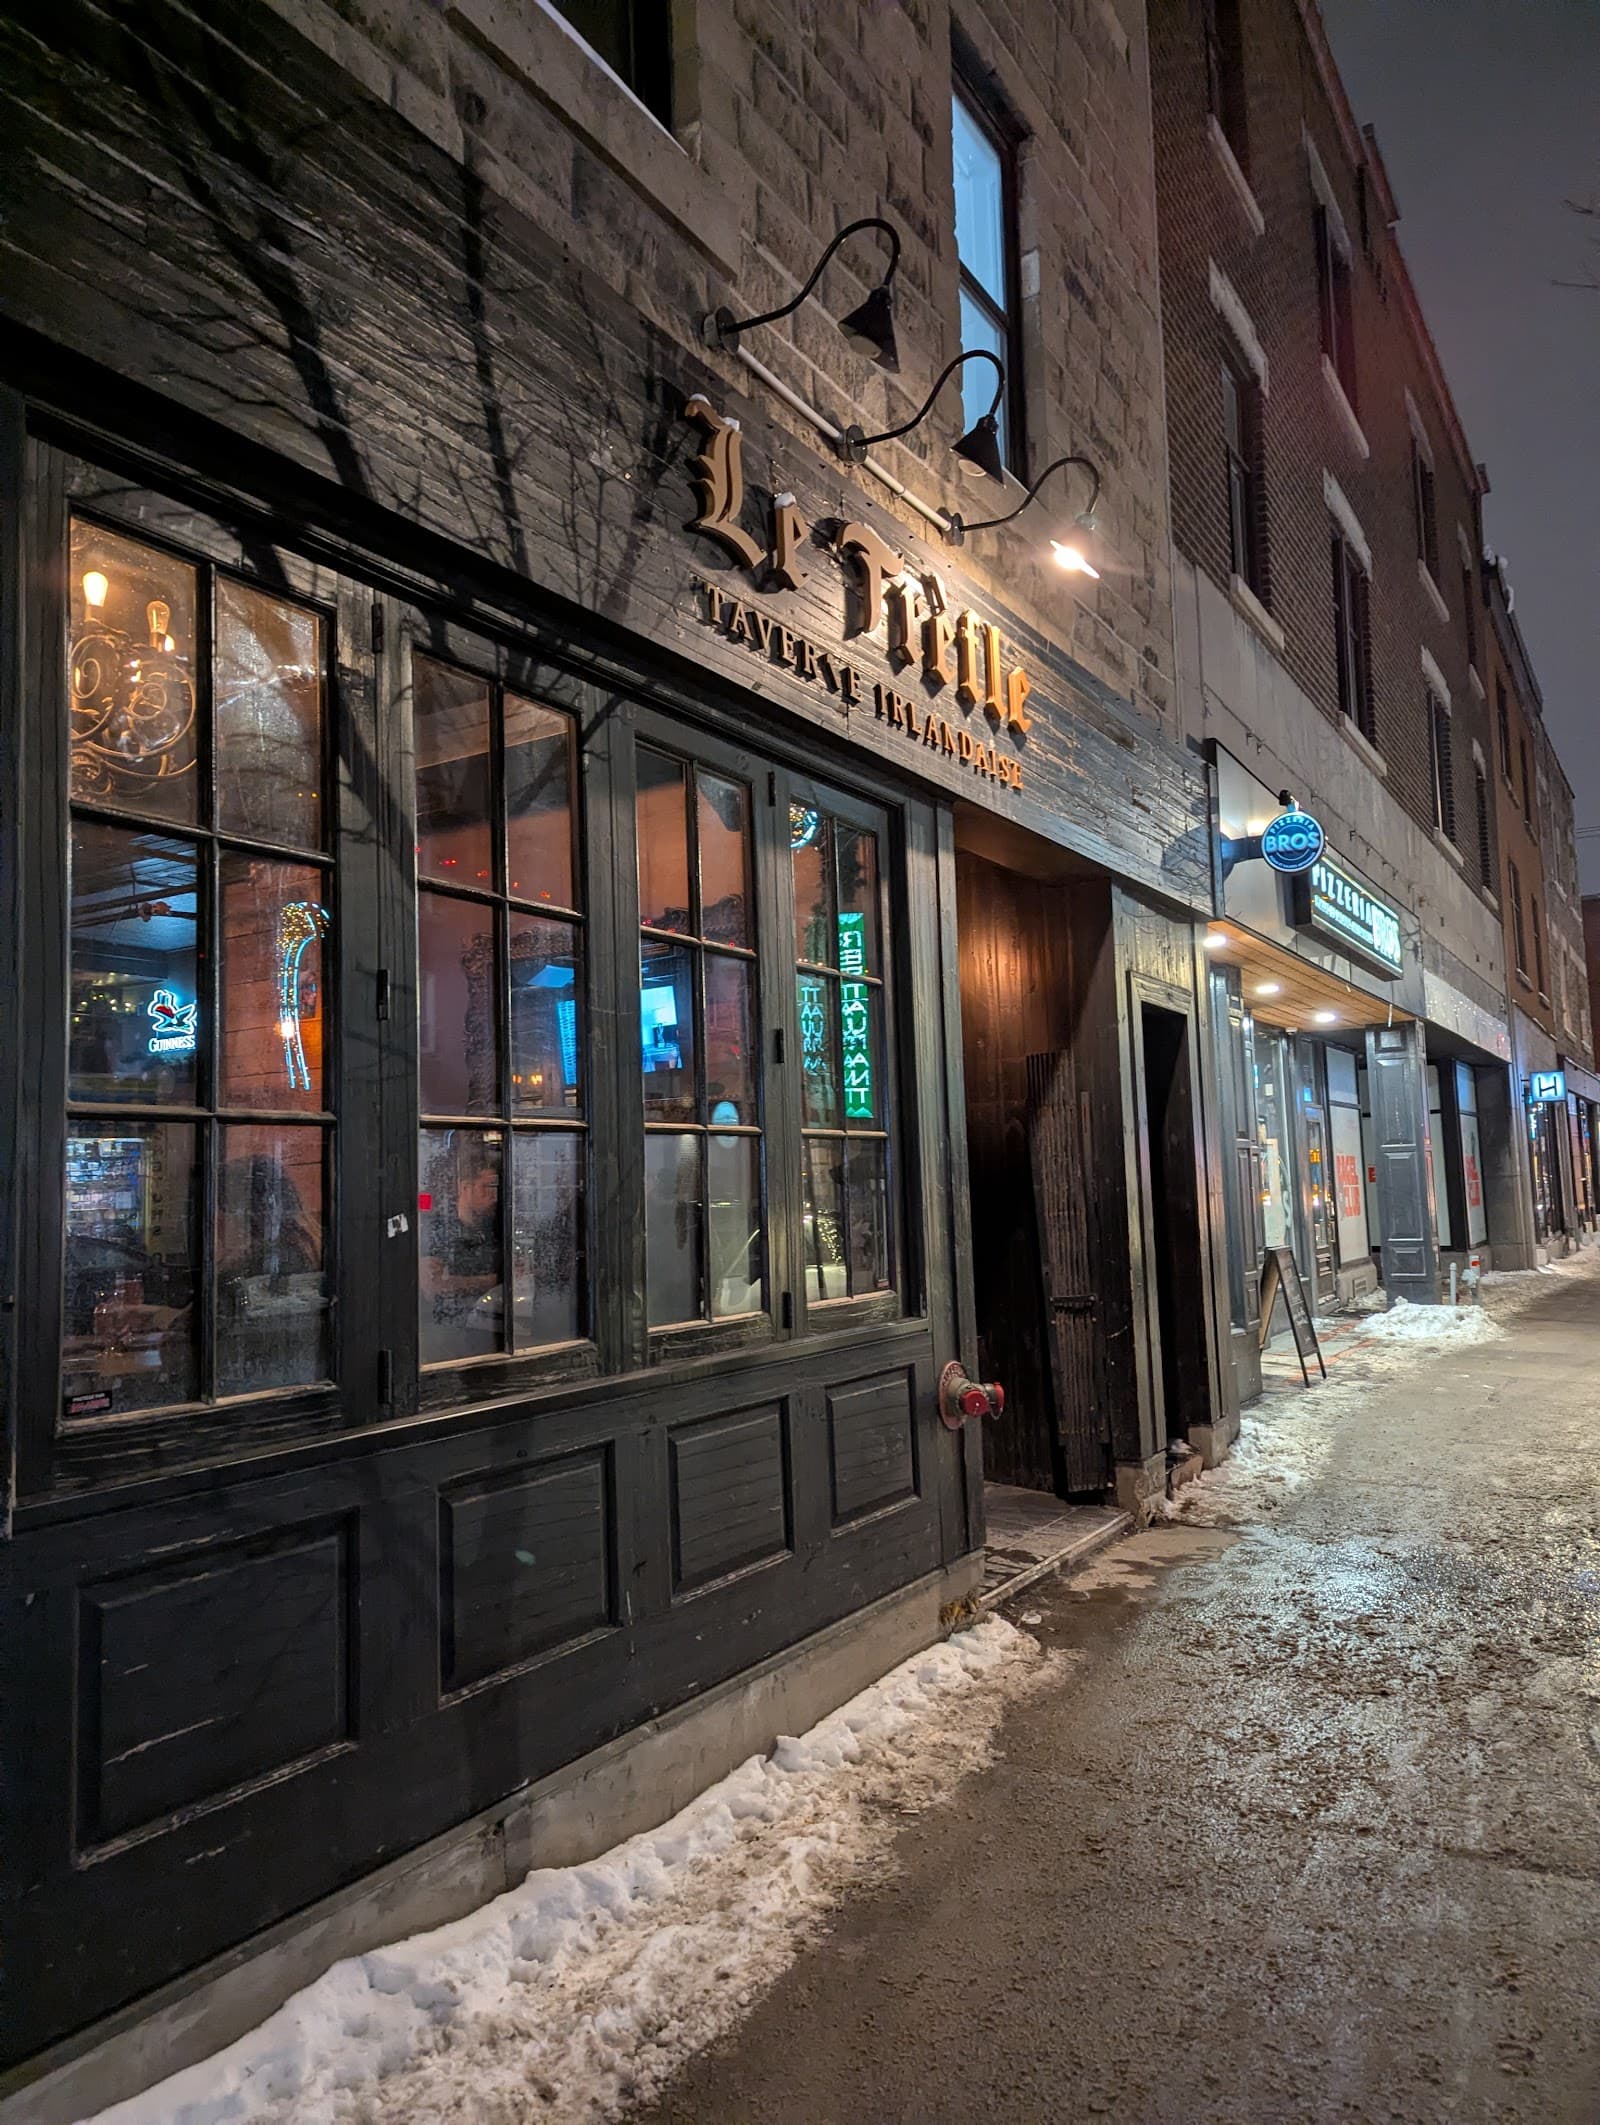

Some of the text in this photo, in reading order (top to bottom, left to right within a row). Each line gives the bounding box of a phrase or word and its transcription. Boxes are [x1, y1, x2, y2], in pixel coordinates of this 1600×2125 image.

[684, 397, 811, 589] Le
[703, 583, 1024, 790] TAVERNE IRLANDAISE
[1270, 815, 1315, 834] PIZZERIA
[1266, 831, 1320, 853] BROS
[1312, 863, 1374, 927] PIZZERIA
[148, 1034, 197, 1053] GUINNESS
[1537, 1075, 1558, 1098] H
